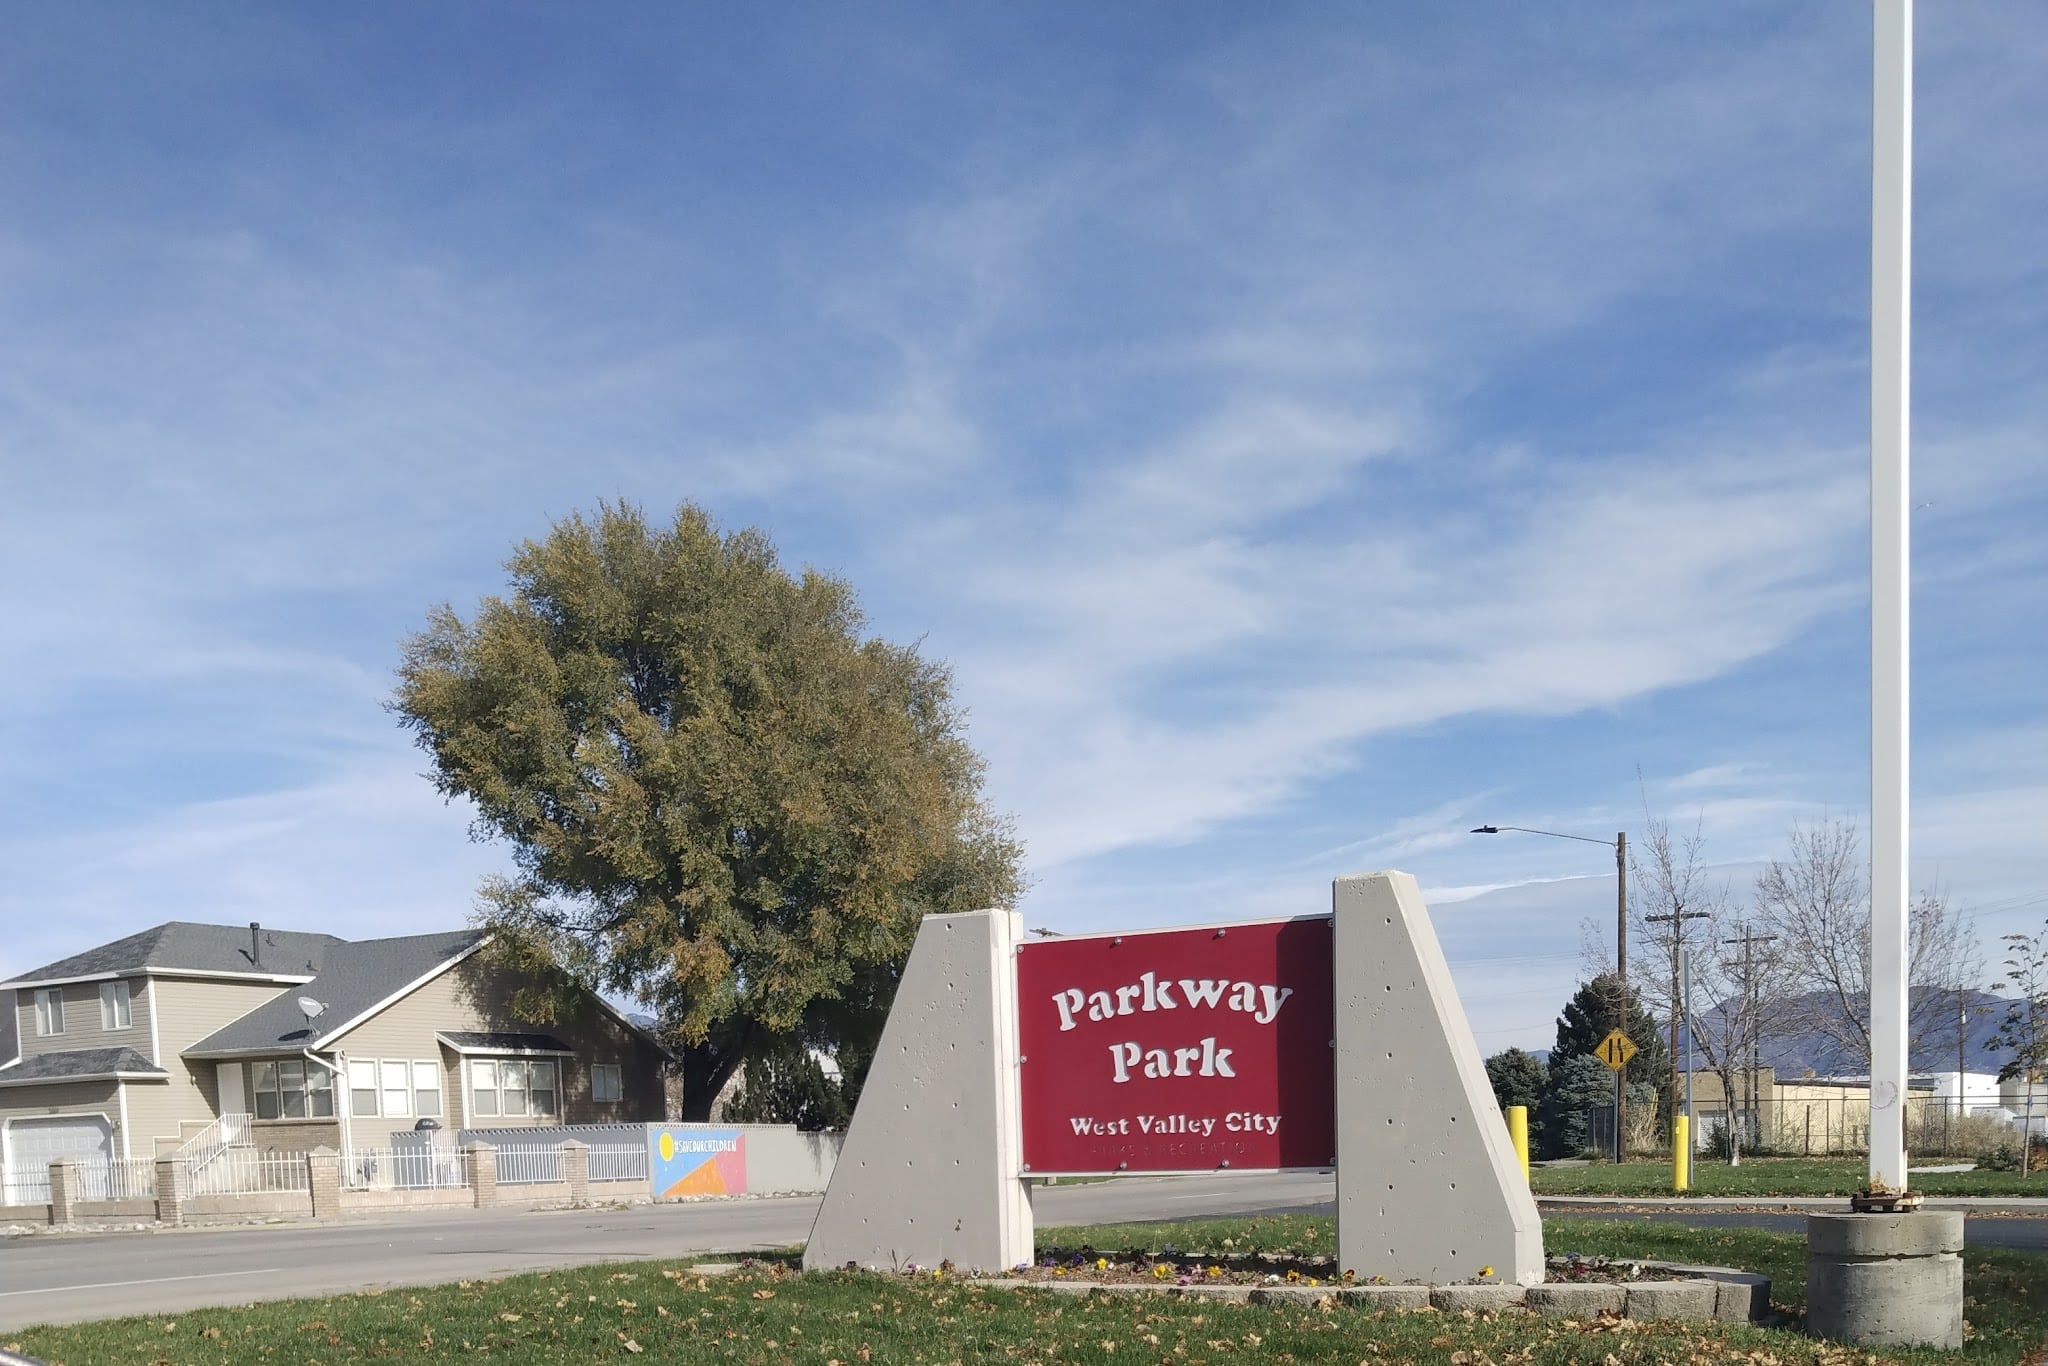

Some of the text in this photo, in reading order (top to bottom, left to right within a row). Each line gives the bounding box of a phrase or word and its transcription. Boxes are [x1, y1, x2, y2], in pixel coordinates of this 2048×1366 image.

[1051, 970, 1294, 1032] Parkway
[1108, 1037, 1236, 1083] Park
[1069, 1111, 1282, 1137] West Valley City
